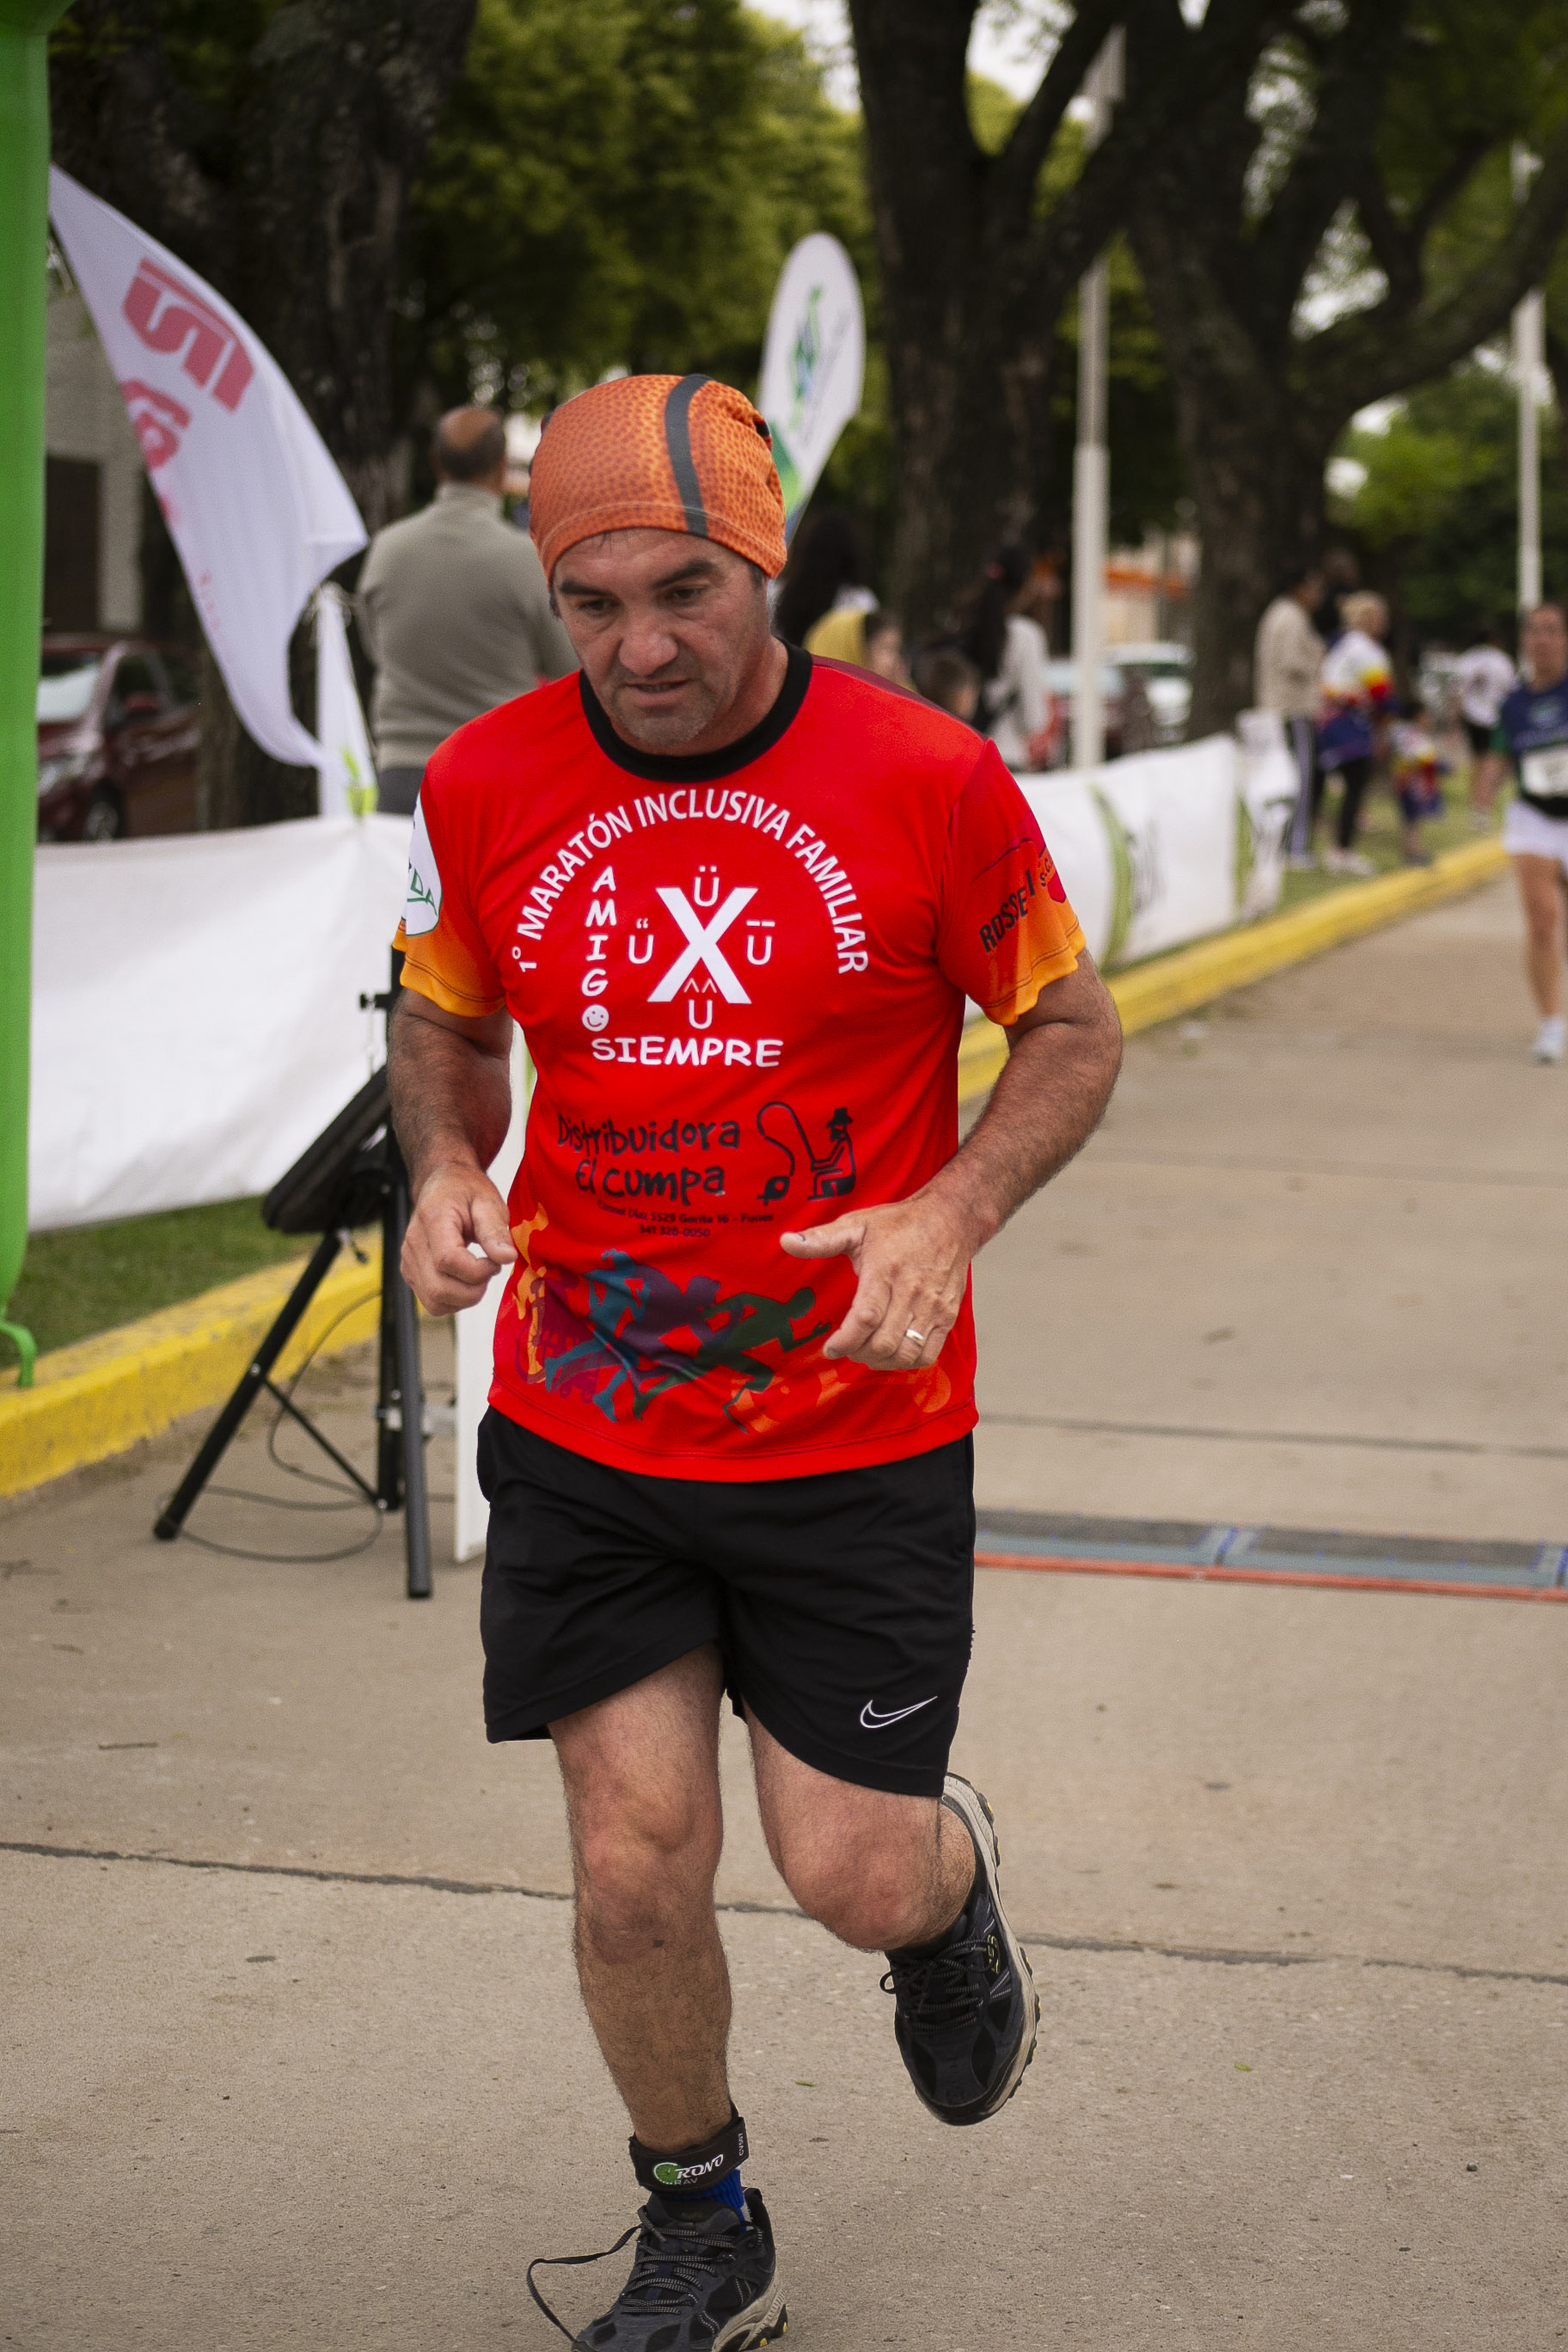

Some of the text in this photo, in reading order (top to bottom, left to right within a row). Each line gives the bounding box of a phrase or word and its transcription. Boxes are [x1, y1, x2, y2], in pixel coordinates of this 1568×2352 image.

[517, 805, 633, 940] MARATÓN
[634, 788, 790, 841] INCLUSIVA
[785, 824, 869, 974] FAMILIAR
[647, 886, 759, 1004] X
[591, 1036, 784, 1068] SIEMPRE
[557, 1112, 740, 1156] Distribuidora
[576, 1158, 597, 1194] El
[679, 1213, 713, 1224] Garita
